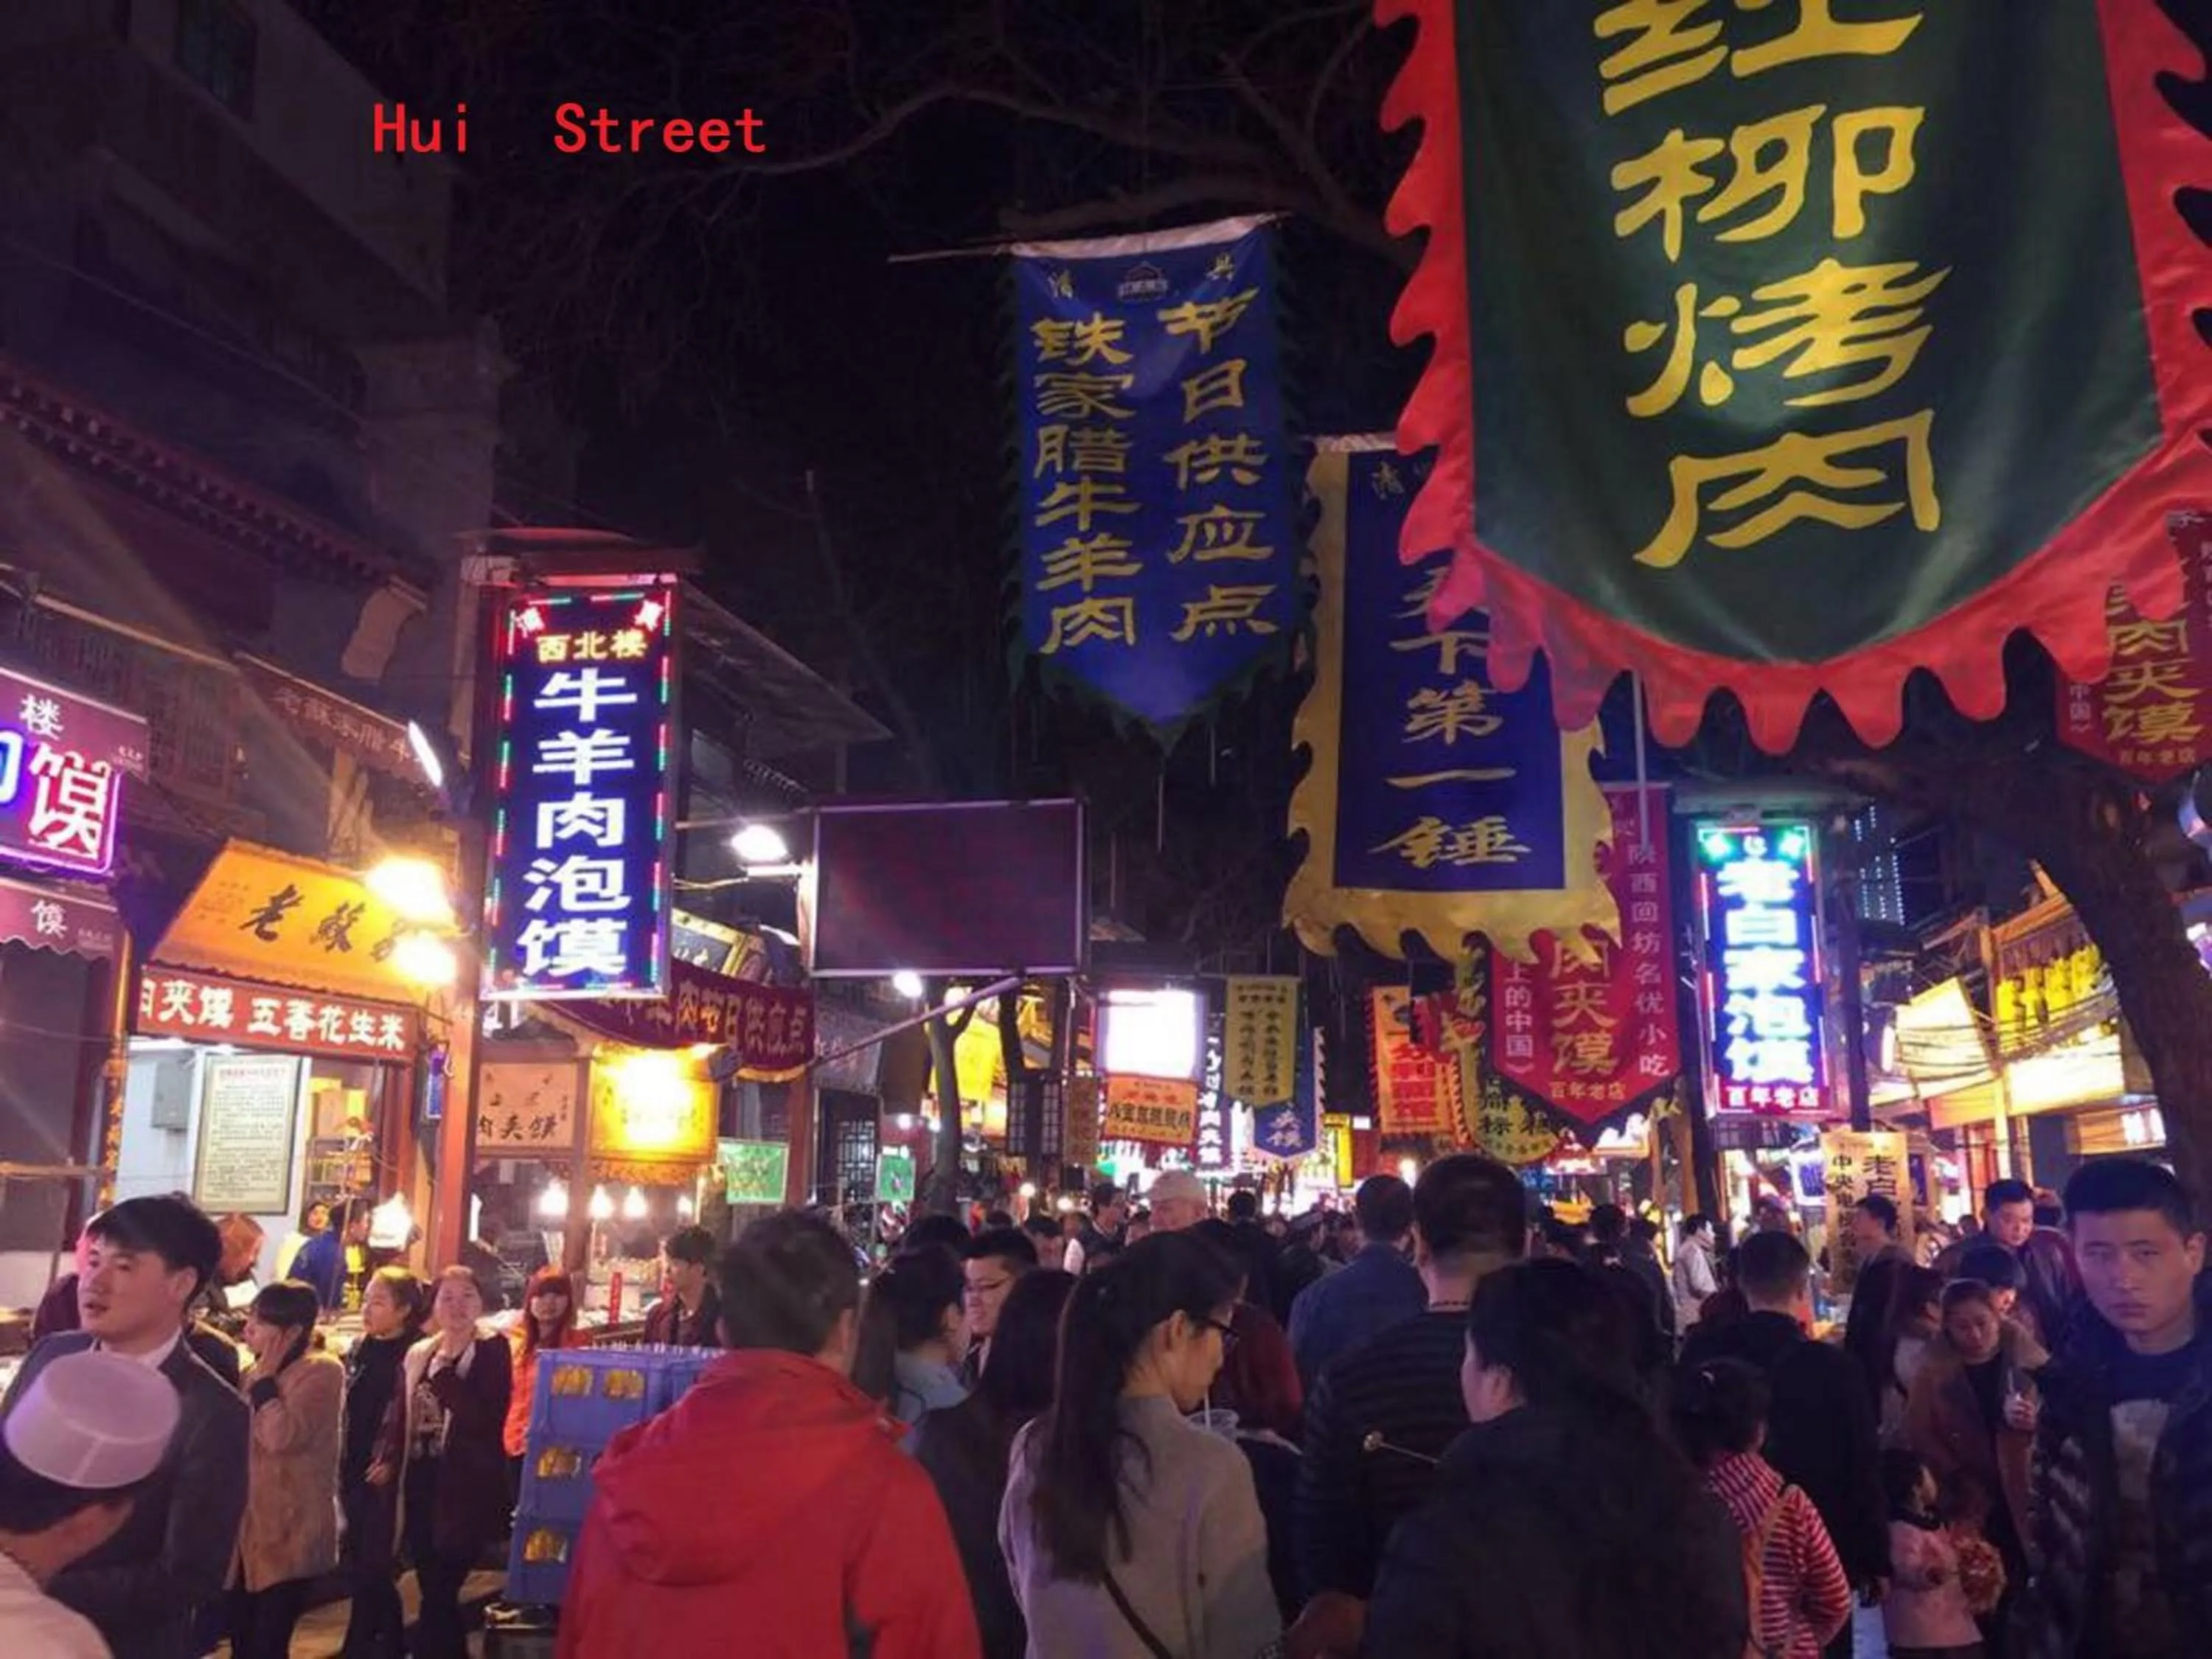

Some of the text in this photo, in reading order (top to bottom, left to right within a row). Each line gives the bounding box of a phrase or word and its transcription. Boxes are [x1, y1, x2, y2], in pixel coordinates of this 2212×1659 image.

[1594, 0, 1952, 568] 红柳烤肉
[1030, 311, 1144, 654] 铁家腊牛羊肉
[1156, 288, 1279, 641] 节日供应点
[536, 629, 648, 664] 西北楼
[2103, 580, 2205, 745] 肉夹馍
[19, 693, 64, 740] 楼
[517, 667, 637, 976] 牛羊肉泡馍
[247, 997, 405, 1052] 五香花生米
[1550, 1080, 1627, 1100] 百年老店
[1727, 1086, 1819, 1107] 百年老店
